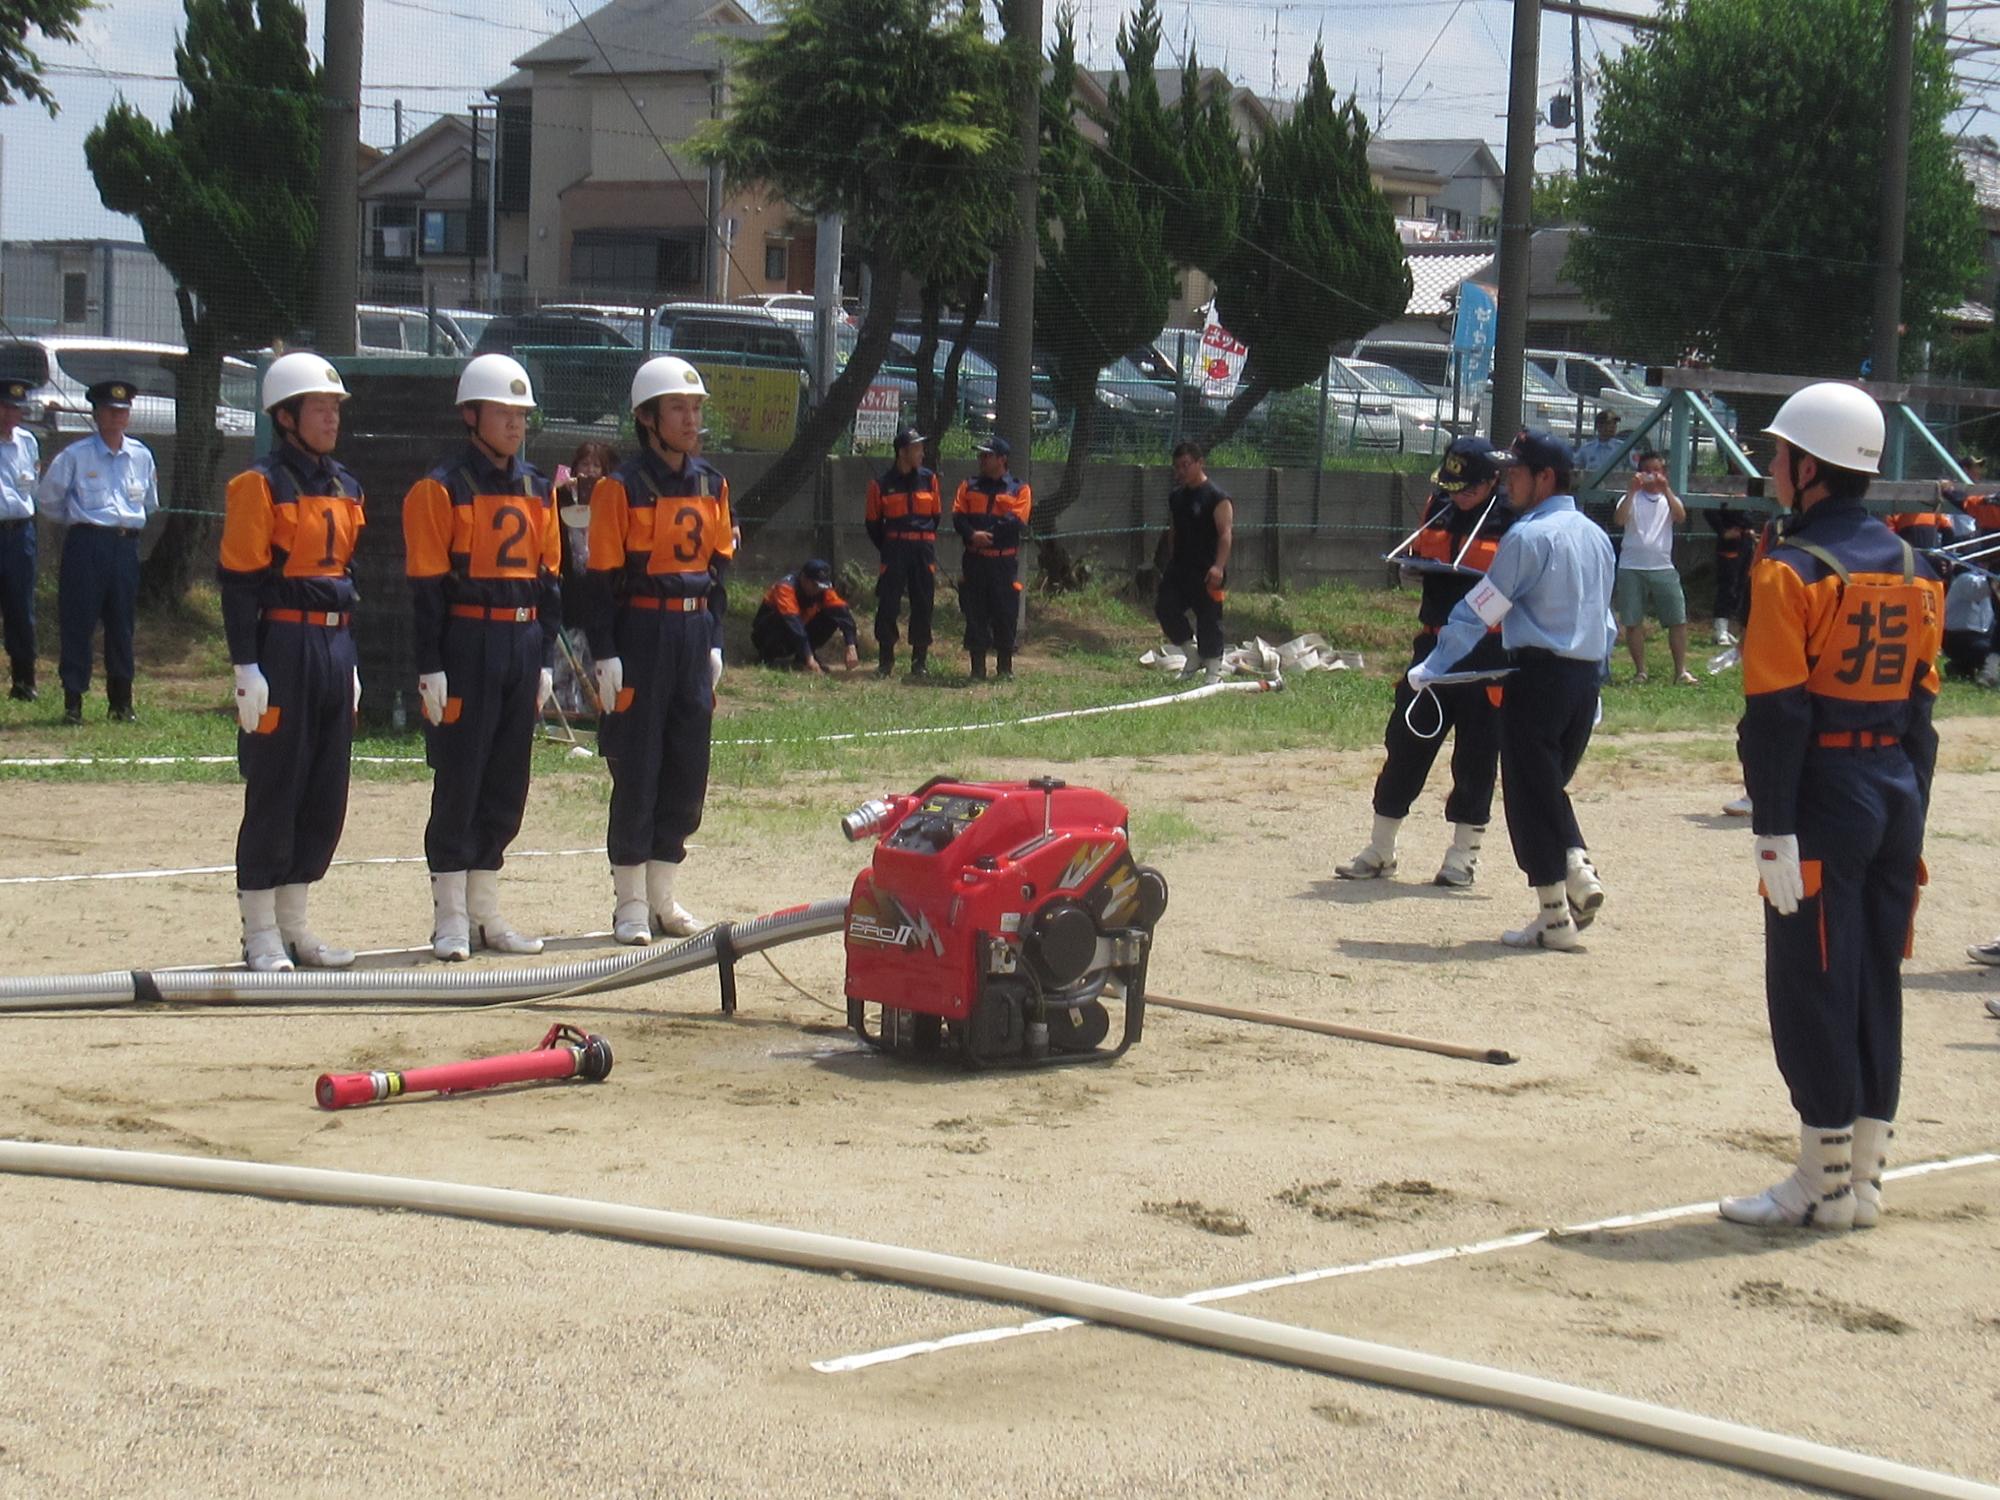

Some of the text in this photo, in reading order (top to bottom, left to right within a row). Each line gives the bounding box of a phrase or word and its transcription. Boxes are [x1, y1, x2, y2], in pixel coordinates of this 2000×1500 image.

[1207, 328, 1245, 352] ネット
[317, 507, 338, 567] 1
[492, 505, 528, 568] 2
[674, 507, 704, 563] 3
[1834, 600, 1909, 685] 指
